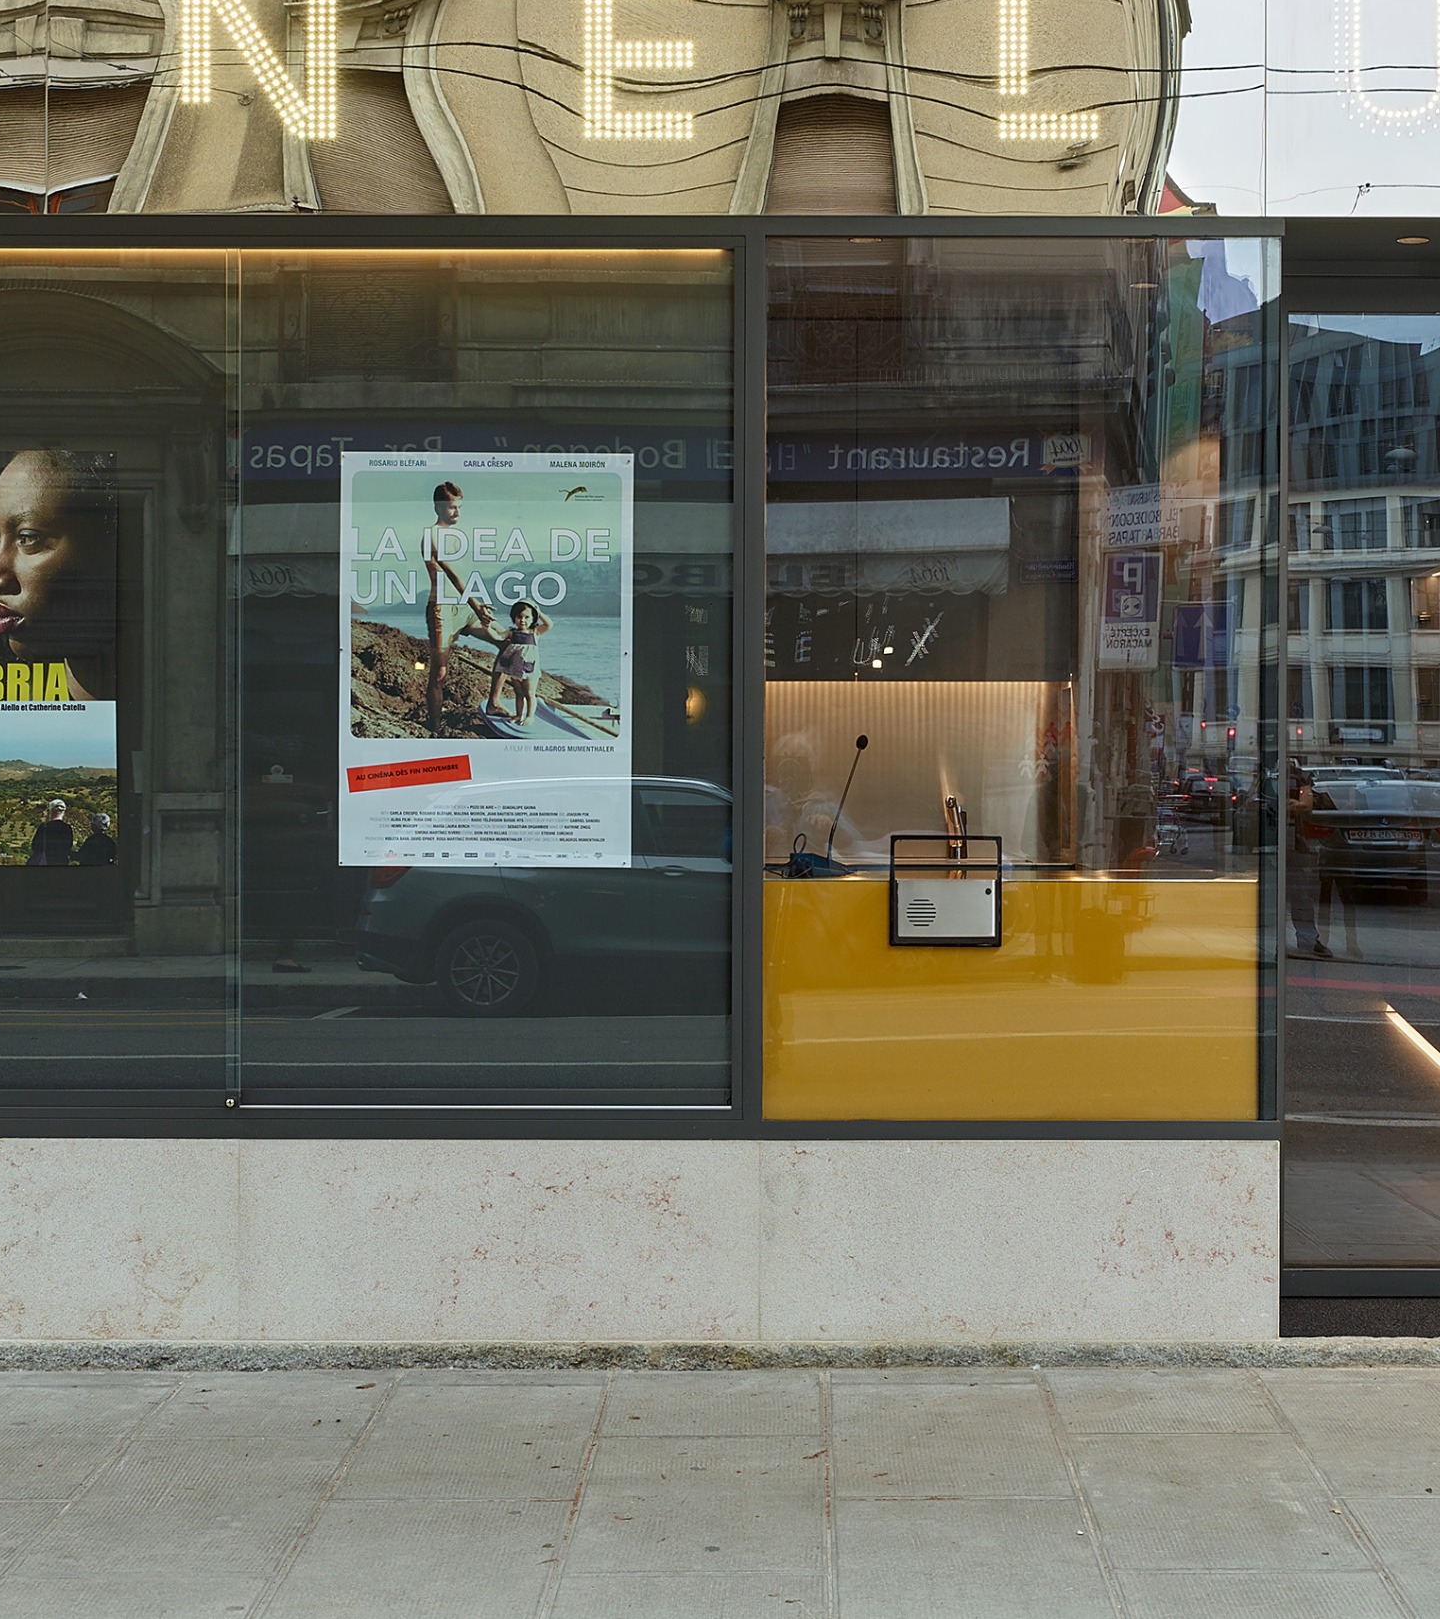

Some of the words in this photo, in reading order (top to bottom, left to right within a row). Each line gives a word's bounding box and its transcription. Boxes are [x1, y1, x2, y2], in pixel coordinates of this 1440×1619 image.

[463, 460, 486, 468] CARLA
[486, 460, 513, 468] CRESPO
[550, 460, 578, 468] MALENA
[351, 527, 406, 562] LA
[423, 527, 534, 563] IDEA
[550, 527, 612, 562] DE
[351, 570, 417, 606] UN
[436, 570, 568, 607] LAGO
[20, 703, 28, 712] et
[28, 703, 61, 712] Catherine
[533, 744, 566, 753] MILAGROS
[567, 744, 615, 753] MUMENTHALER
[356, 773, 367, 781] AU
[367, 769, 394, 780] CINÉMA
[395, 768, 409, 777] DÈS
[409, 767, 421, 775] FIN
[422, 763, 459, 774] NOVEMBRE
